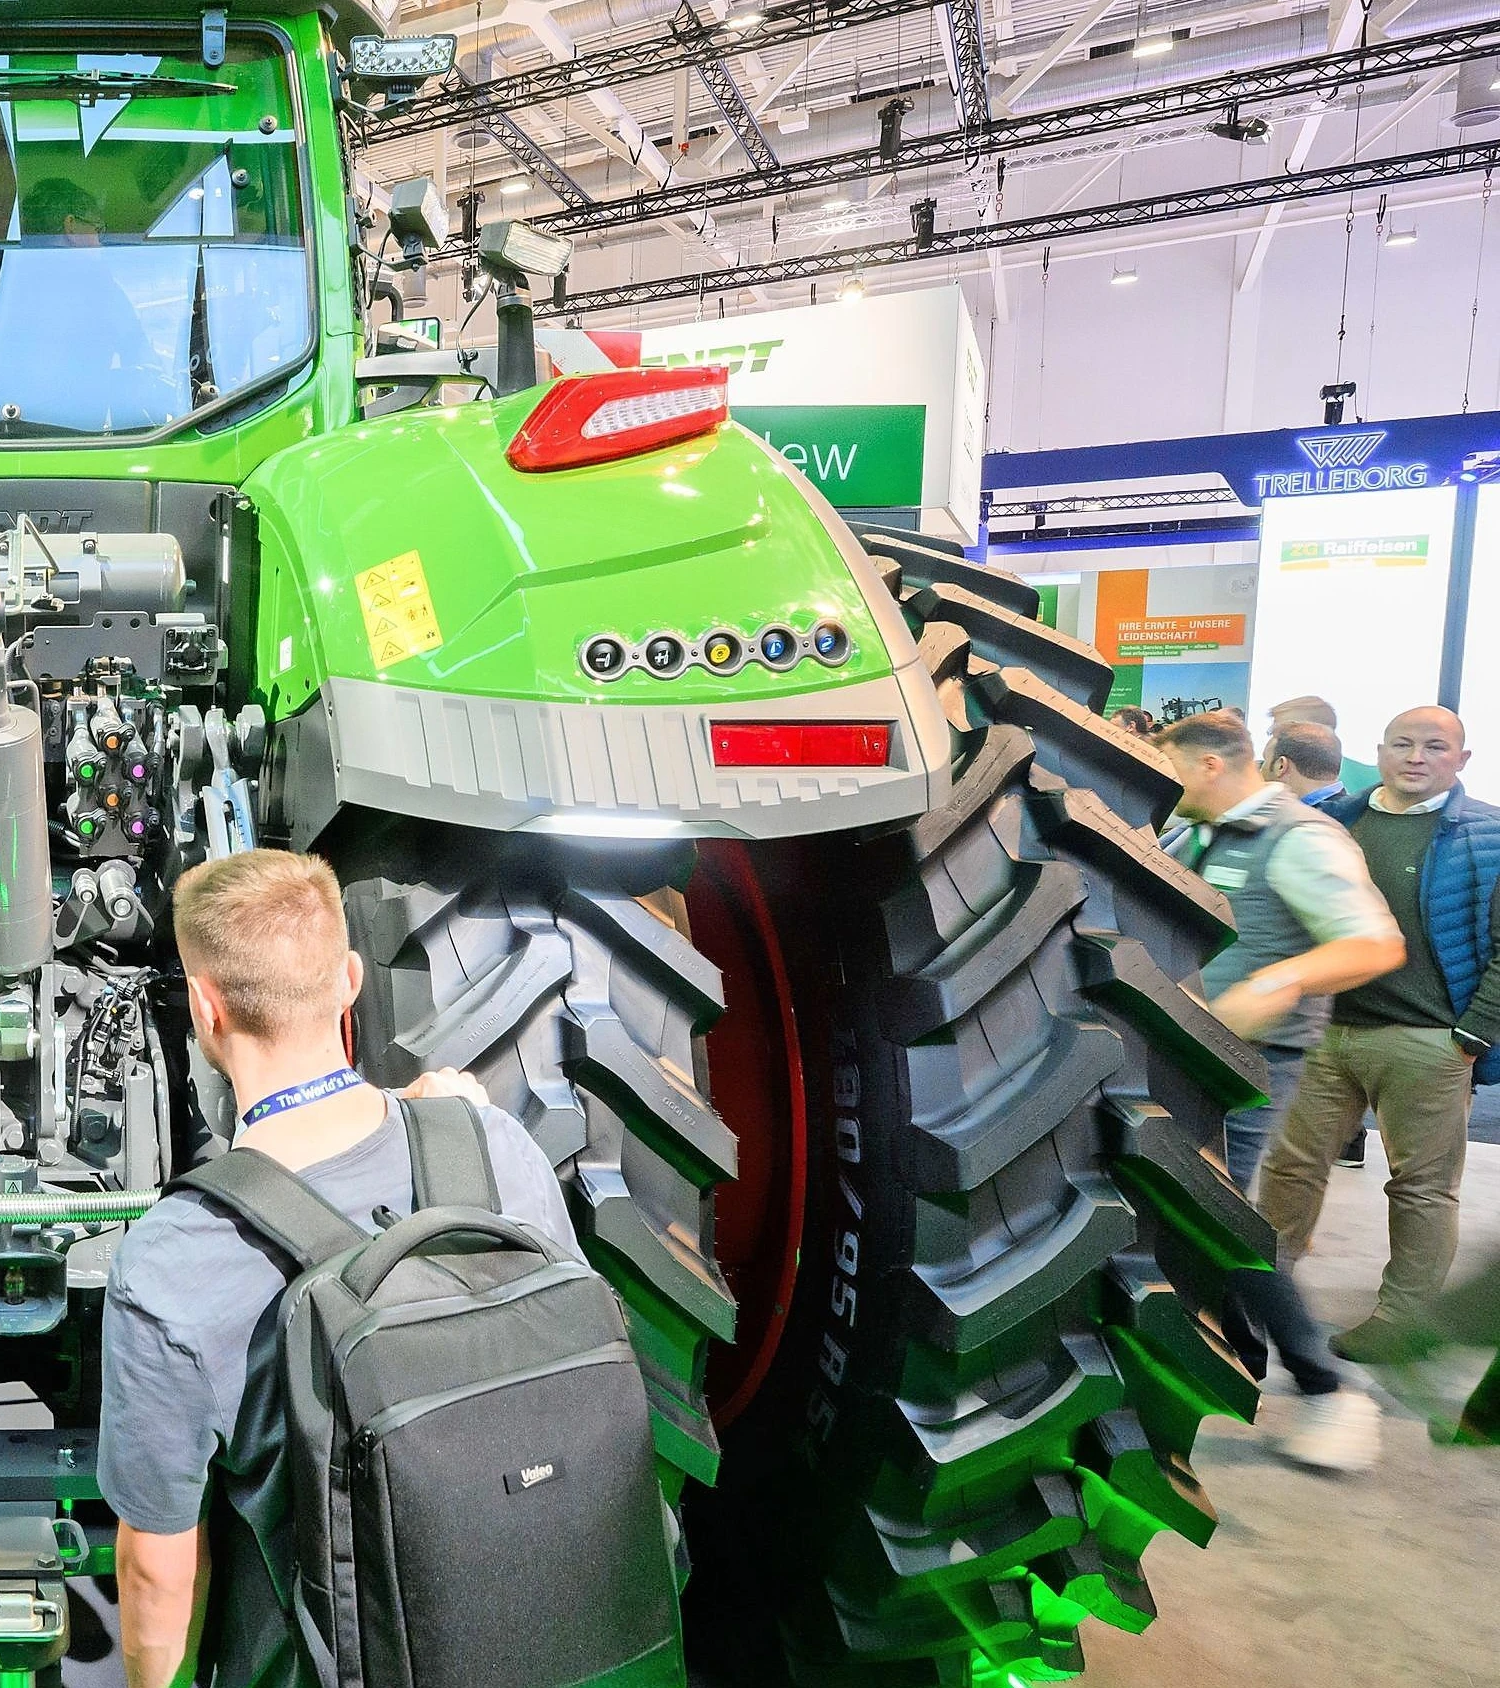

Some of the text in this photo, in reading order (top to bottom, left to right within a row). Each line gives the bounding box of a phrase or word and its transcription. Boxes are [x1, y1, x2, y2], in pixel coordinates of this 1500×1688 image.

[764, 431, 858, 480] ew
[1256, 464, 1427, 496] TRELLEBORG
[1323, 540, 1418, 555] Raiffeisen
[1118, 622, 1141, 630] IHRE
[1144, 620, 1177, 629] ERNTE
[1189, 619, 1231, 628] UNSERE
[1118, 631, 1197, 641] LEIDENSCHAFT!
[276, 1092, 302, 1108] The
[301, 1076, 345, 1100] World's
[521, 1464, 554, 1482] Valeo
